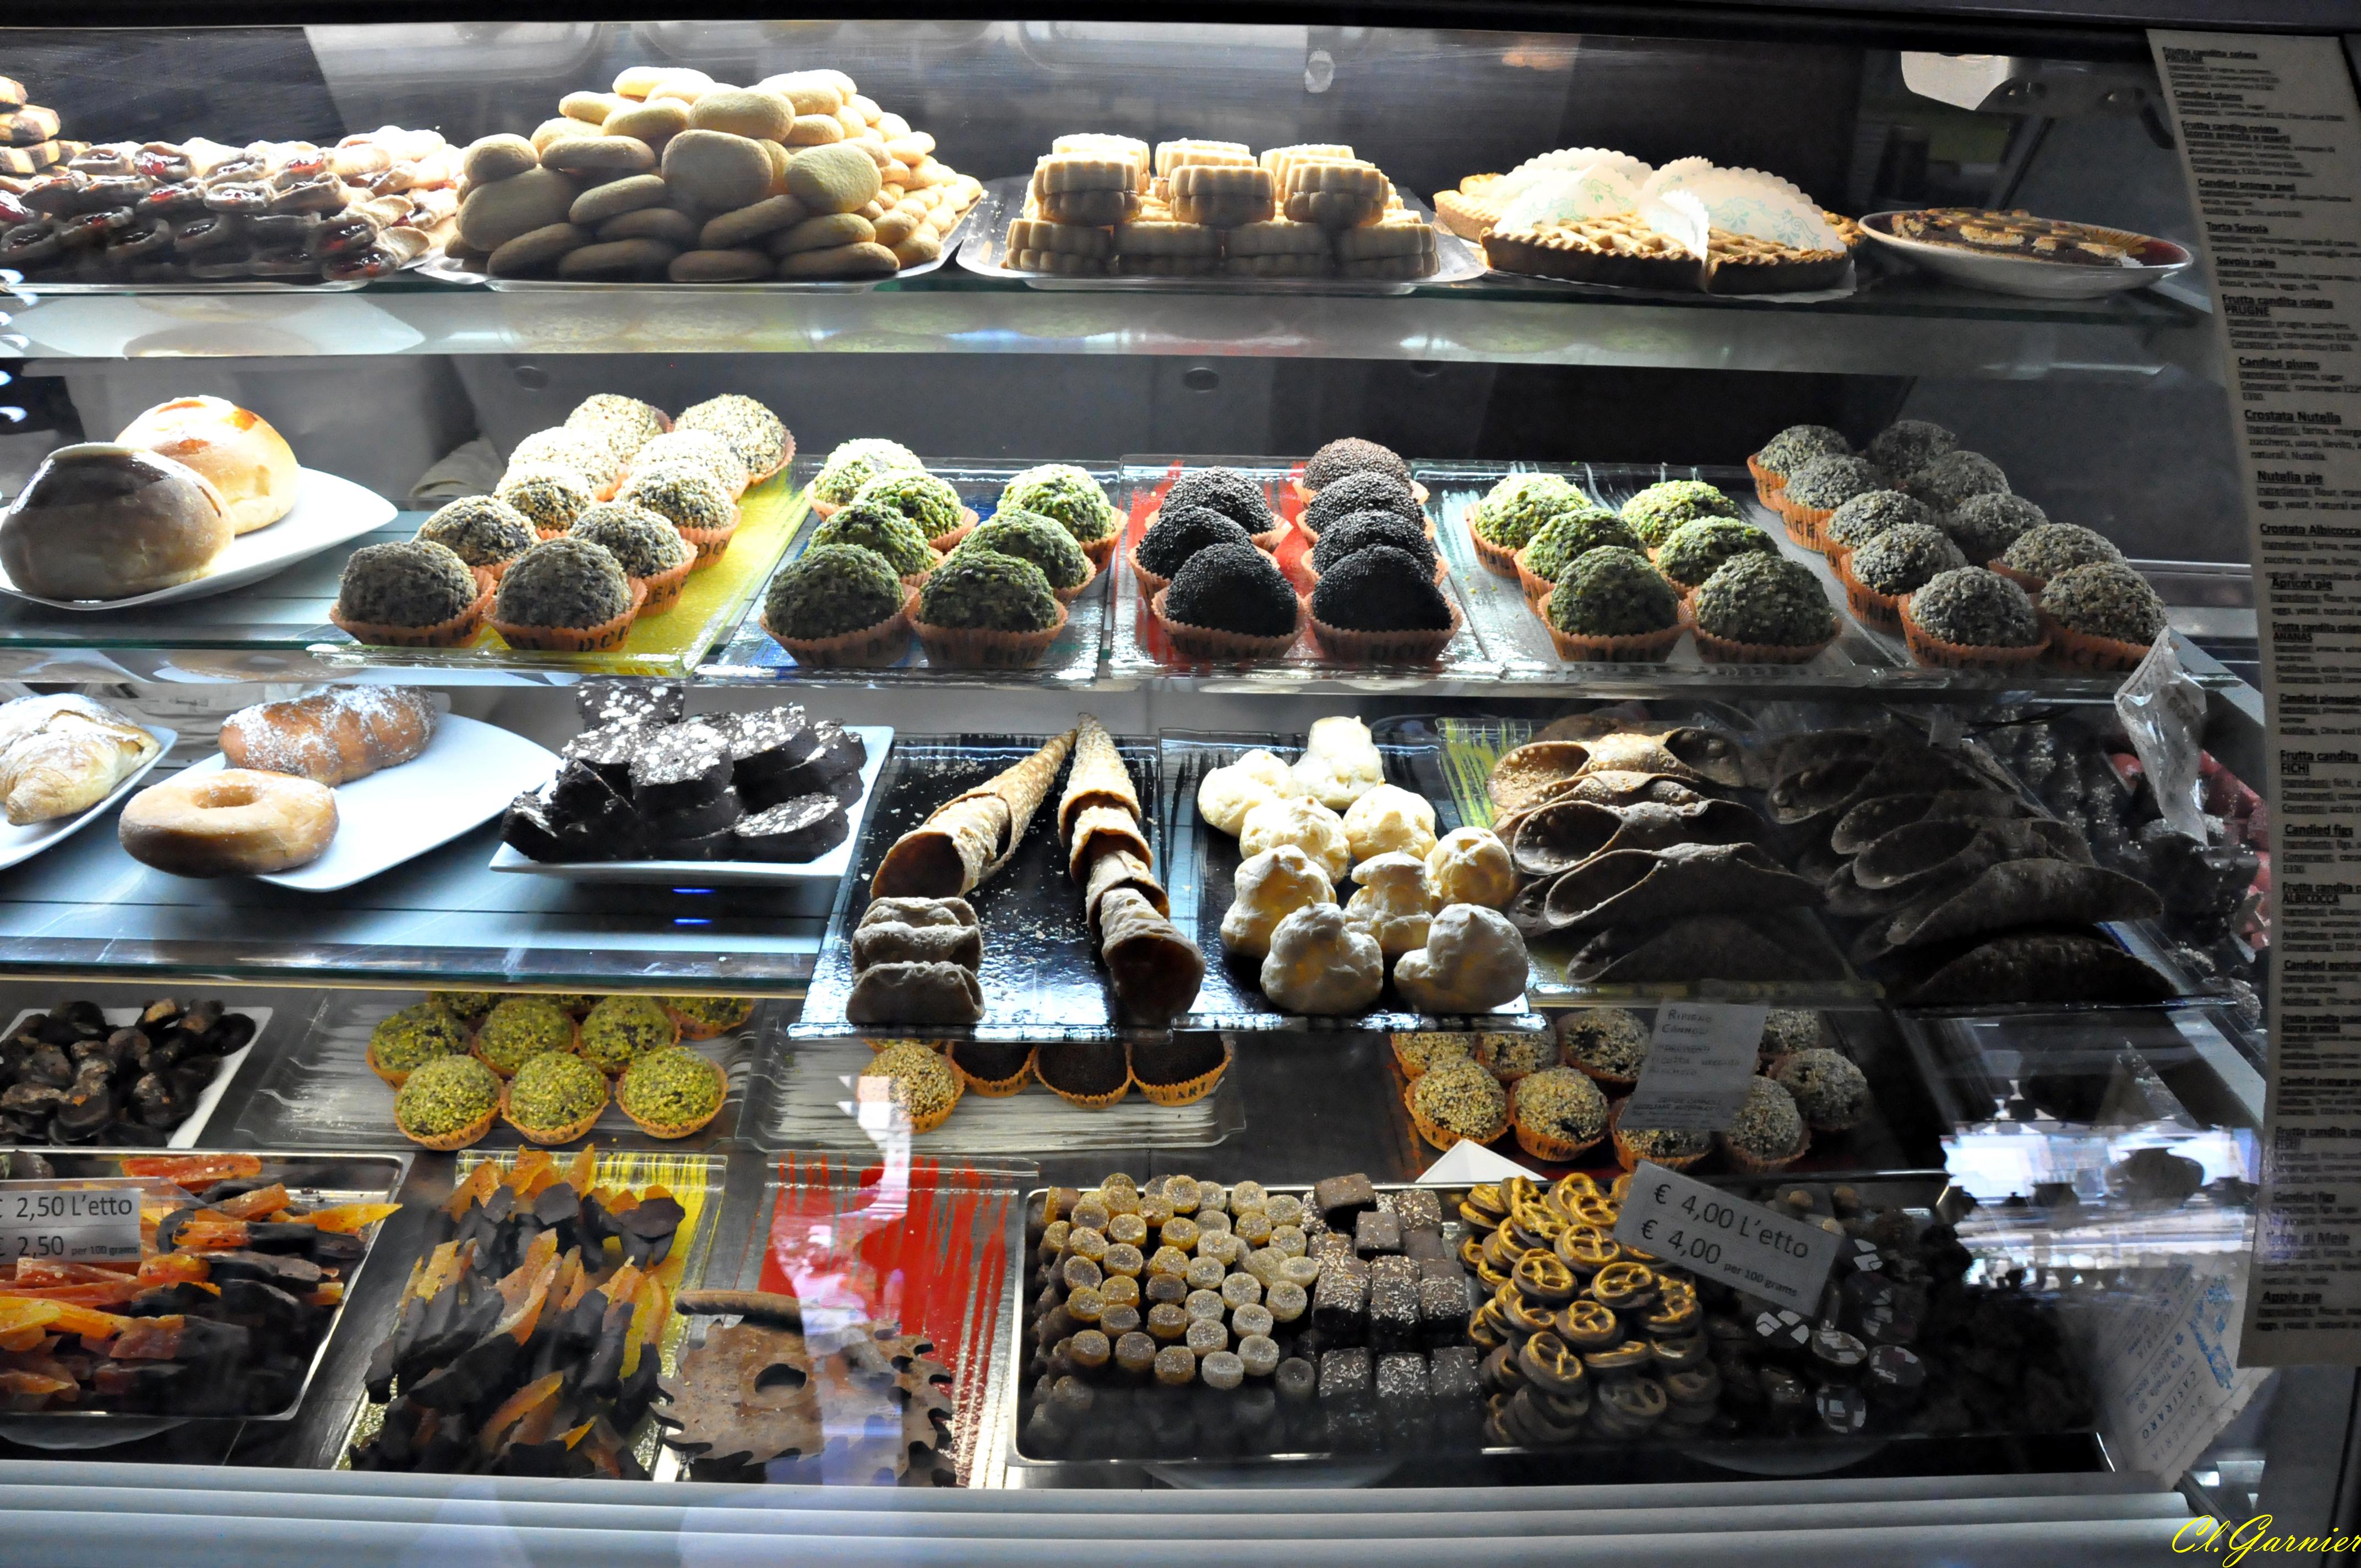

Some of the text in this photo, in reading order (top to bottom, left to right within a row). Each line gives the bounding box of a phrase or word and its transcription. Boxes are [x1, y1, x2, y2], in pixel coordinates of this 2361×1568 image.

[2224, 305, 2270, 315] PRUGNE
[2238, 357, 2320, 370] Candied plums
[2244, 409, 2342, 424] Crostata Nutella
[2257, 470, 2323, 484] Nutella pie
[2260, 523, 2361, 536] Crostata Albicocca
[2272, 576, 2333, 591] Apricot pie
[2273, 632, 2313, 642] ANANAS
[2280, 749, 2359, 761] Frutta candita
[2281, 763, 2309, 774] FICHI
[2285, 824, 2353, 837] Candied figs
[16, 1194, 133, 1222] 2,50 L'etto
[1653, 1183, 1809, 1259] € 4,00 L'etto
[2318, 1232, 2350, 1244] Mele
[17, 1235, 138, 1259] 2,50 per 100 grams
[1641, 1219, 1798, 1297] € 4,00 per 100 grams
[2262, 1291, 2322, 1304] Apple pie
